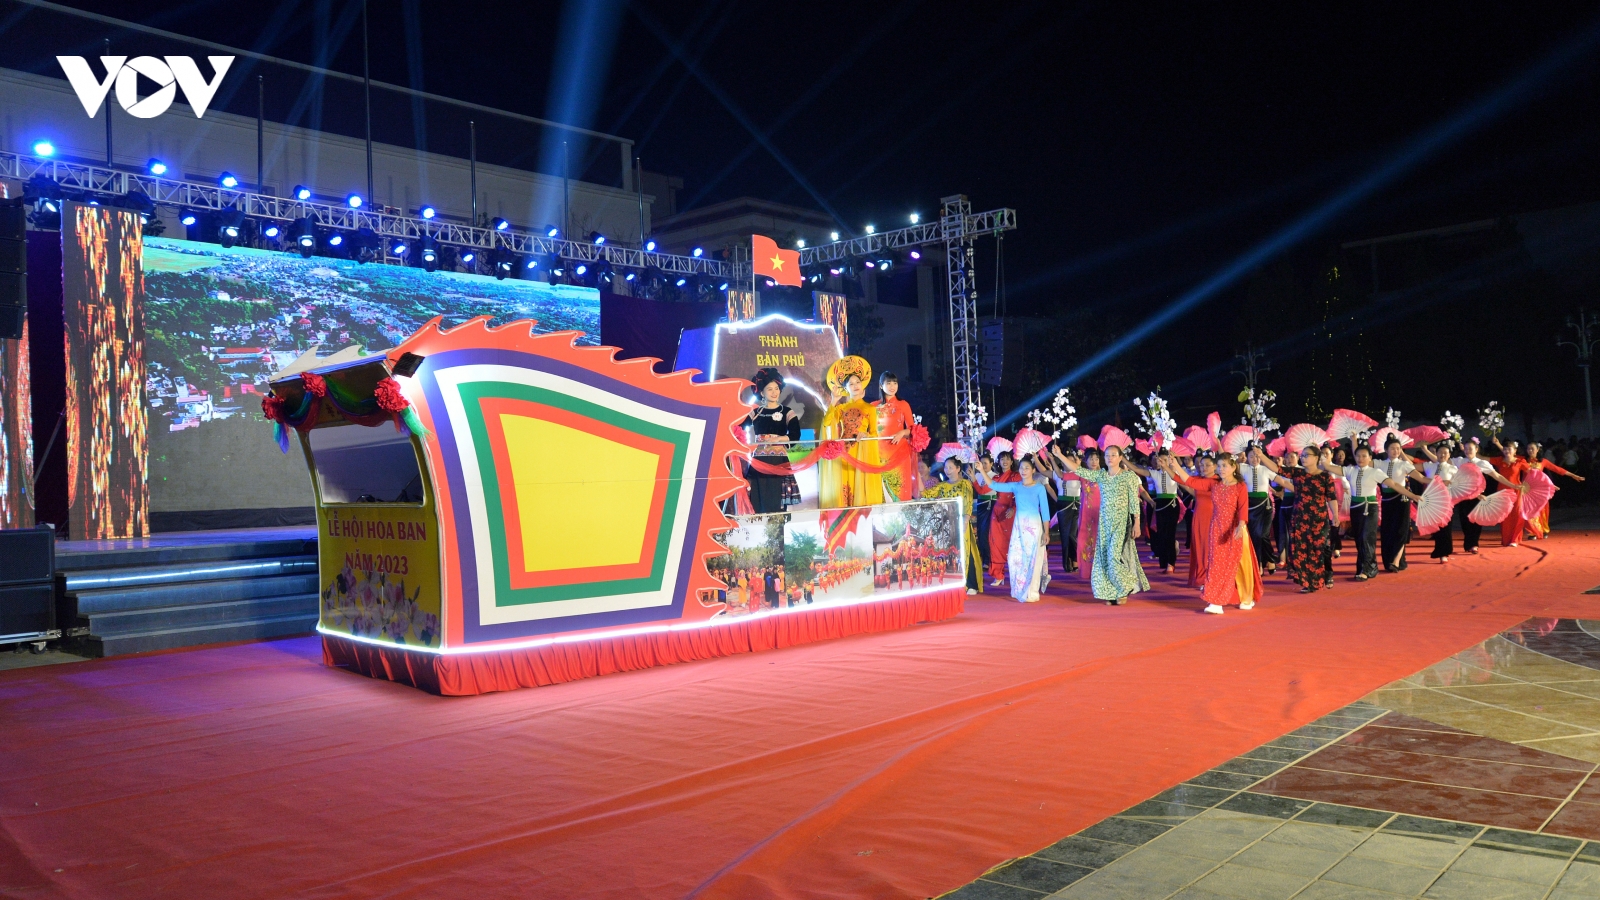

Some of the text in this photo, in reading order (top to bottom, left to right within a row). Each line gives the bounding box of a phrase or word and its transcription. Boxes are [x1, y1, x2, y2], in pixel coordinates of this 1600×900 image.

[758, 333, 799, 348] THÀNH
[782, 351, 805, 367] PHỦ
[328, 510, 427, 543] LỄ HỘI HOA BAN
[345, 549, 409, 576] NĂM 2023
